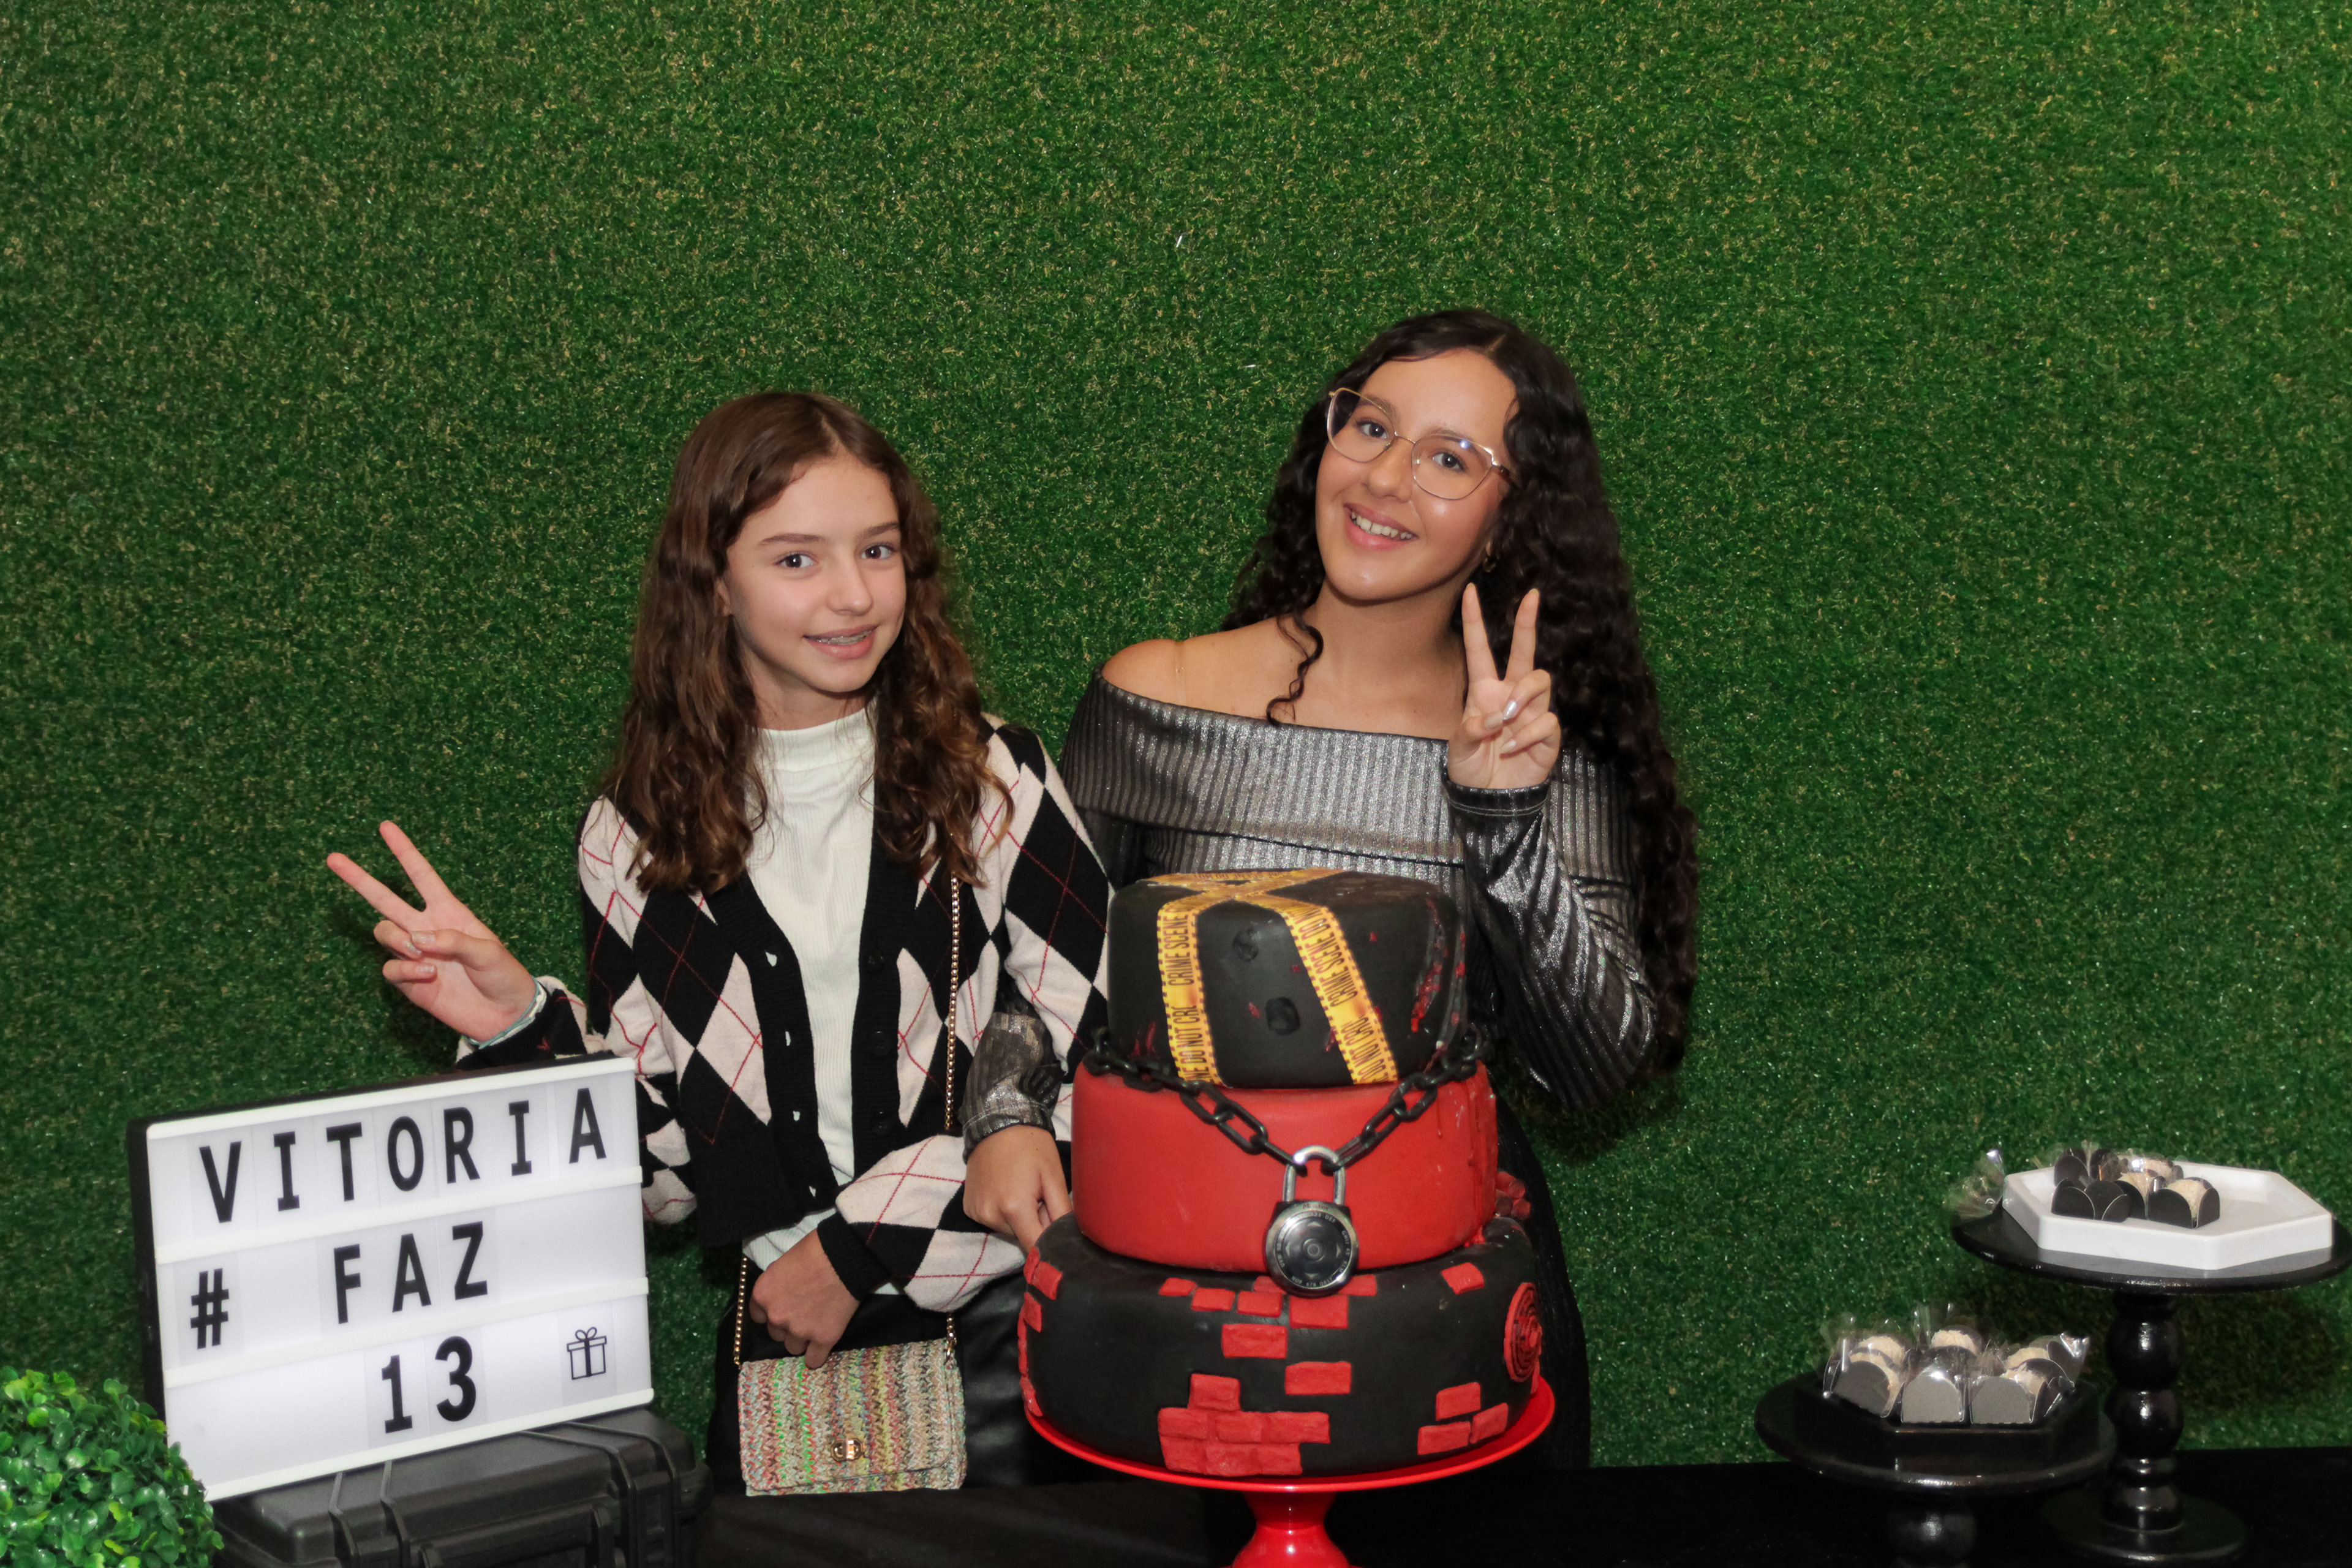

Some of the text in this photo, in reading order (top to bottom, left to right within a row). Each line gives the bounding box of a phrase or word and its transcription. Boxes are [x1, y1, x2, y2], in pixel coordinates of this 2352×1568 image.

[1163, 914, 1190, 949] SCENE
[1298, 918, 1331, 940] DO
[1164, 952, 1194, 986] CRIME
[1305, 931, 1345, 974] SCENE
[1319, 965, 1359, 1008] CRIME
[1174, 1027, 1204, 1047] NOT
[1348, 1038, 1382, 1068] NOT
[1178, 1050, 1207, 1064] DO
[1357, 1058, 1386, 1083] DO
[199, 1087, 606, 1223] VITORIA
[190, 1221, 488, 1349] # FAZ
[382, 1336, 477, 1434] 13
